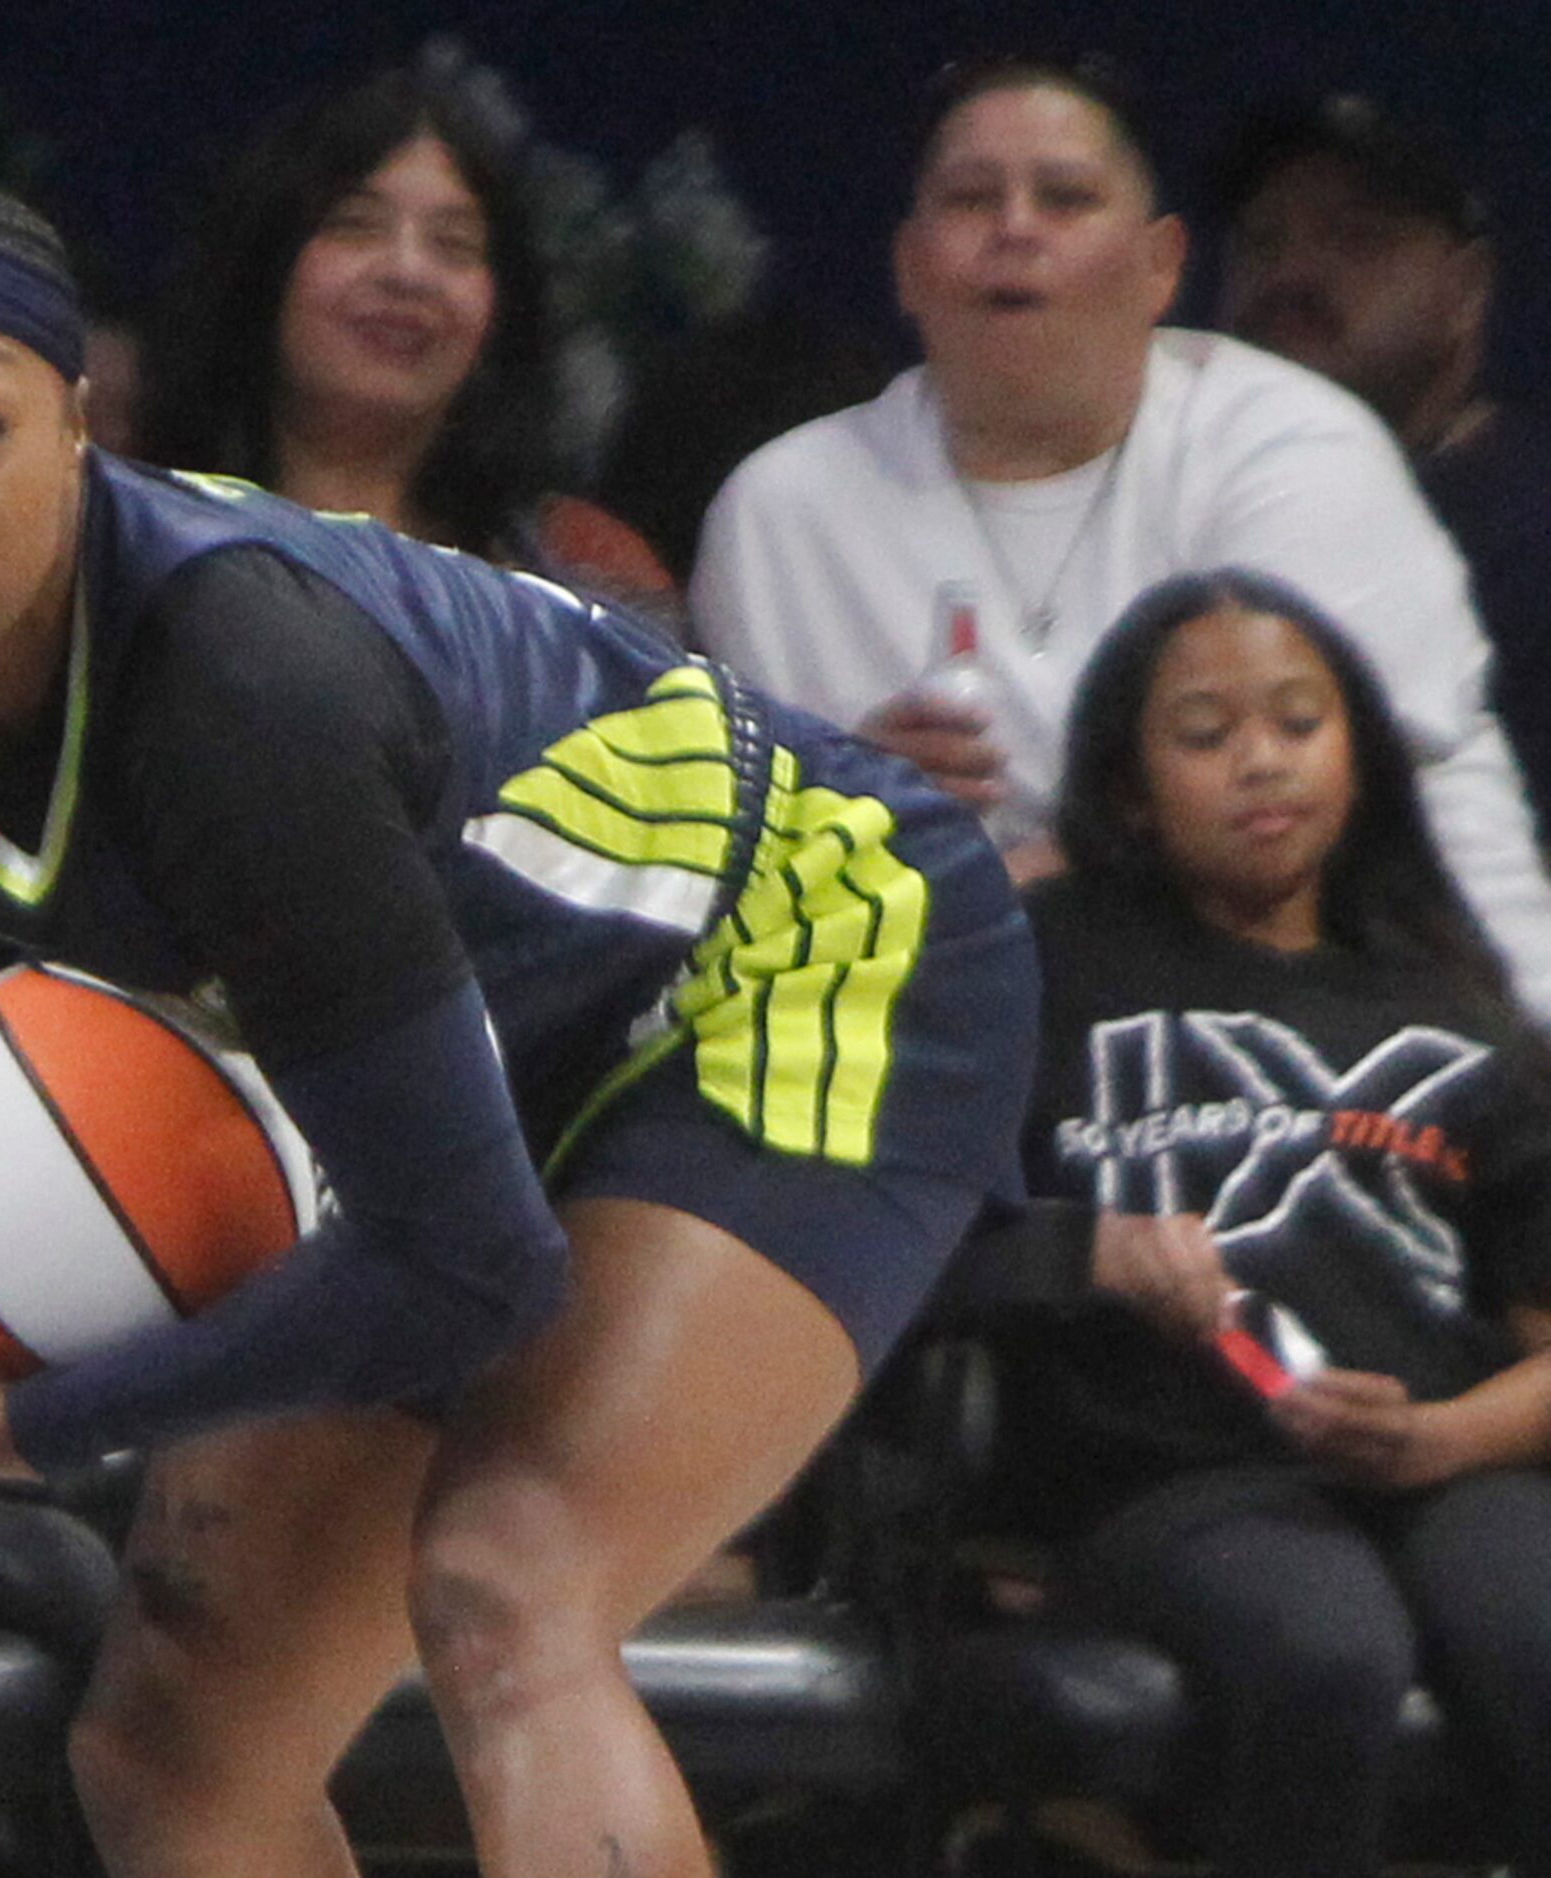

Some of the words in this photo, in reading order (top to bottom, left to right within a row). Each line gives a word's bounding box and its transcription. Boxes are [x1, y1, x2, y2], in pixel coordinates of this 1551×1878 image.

[1091, 1010, 1495, 1312] IX
[1115, 1098, 1249, 1158] YEARS
[1255, 1104, 1325, 1141] OF
